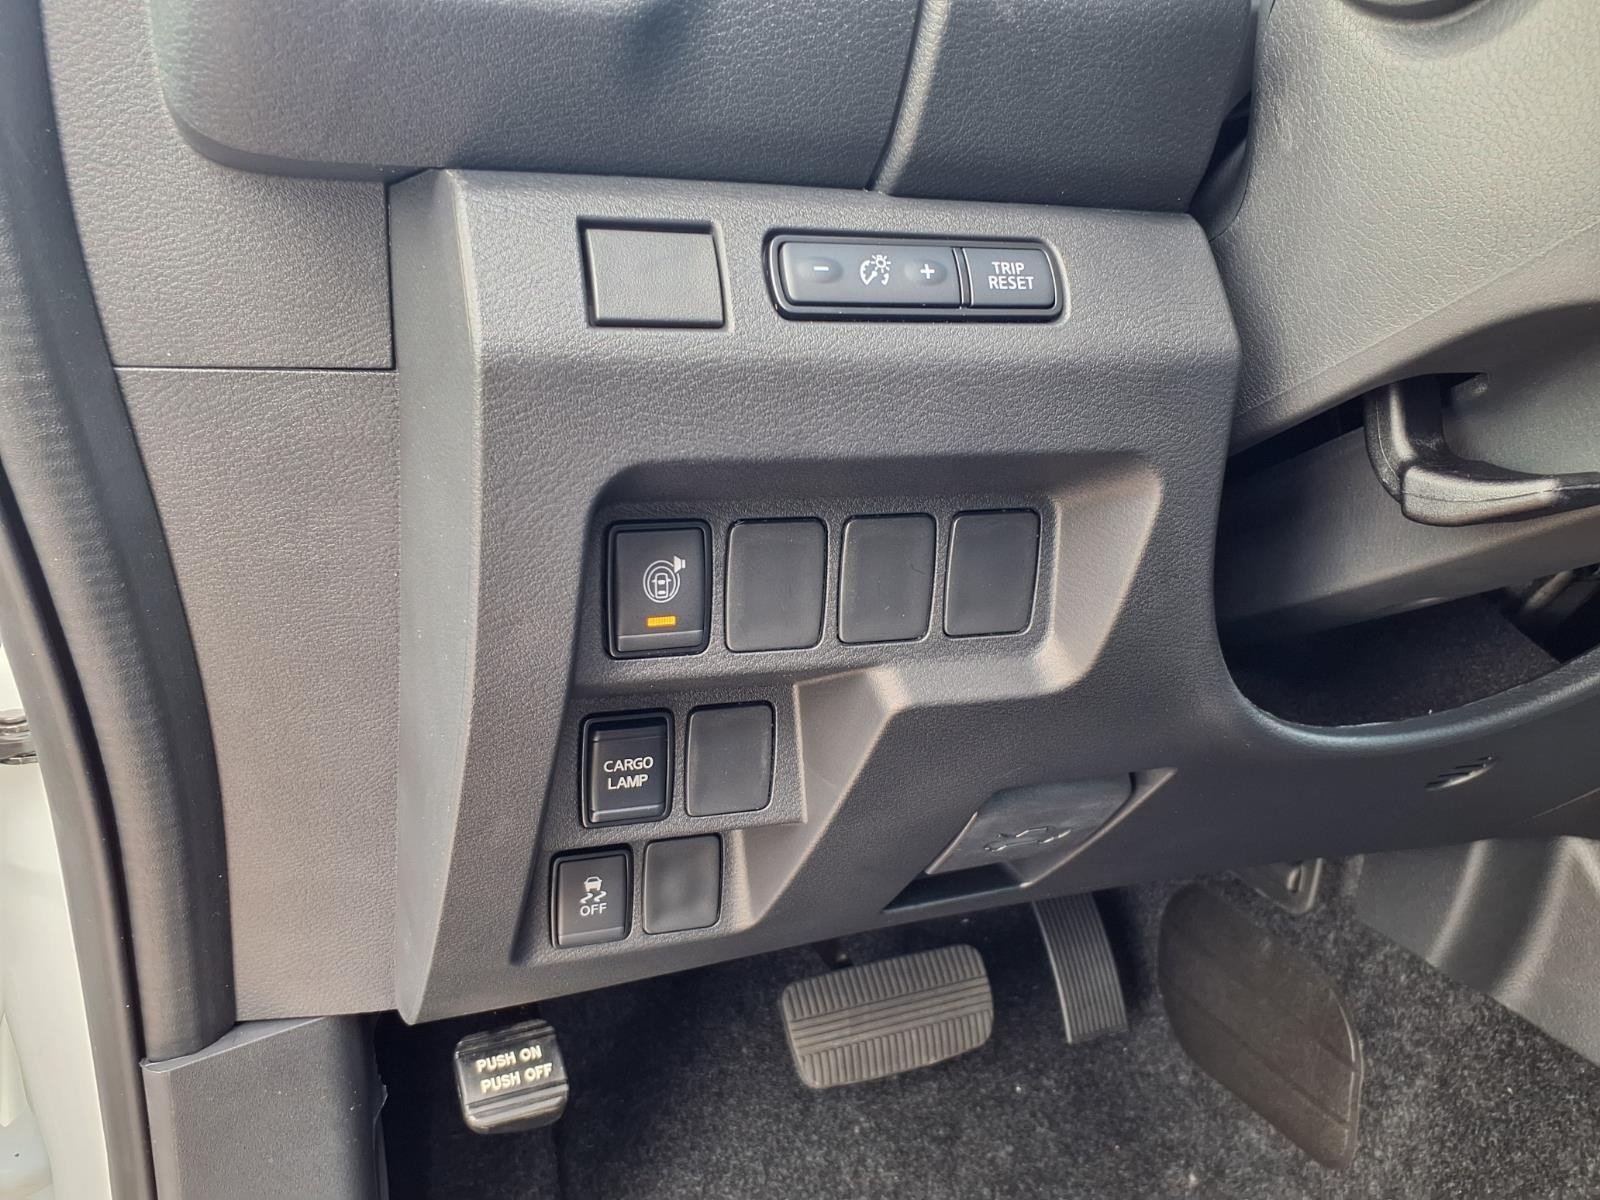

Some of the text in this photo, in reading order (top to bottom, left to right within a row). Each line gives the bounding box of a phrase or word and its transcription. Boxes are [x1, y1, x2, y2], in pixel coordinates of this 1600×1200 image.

[991, 262, 1025, 275] TRIP
[988, 276, 1034, 290] RESET
[603, 756, 654, 773] CARGO
[607, 774, 649, 790] LAMP
[579, 903, 607, 917] OFF
[476, 1045, 542, 1073] PUSH ON
[480, 1063, 553, 1094] PUSH OFF
